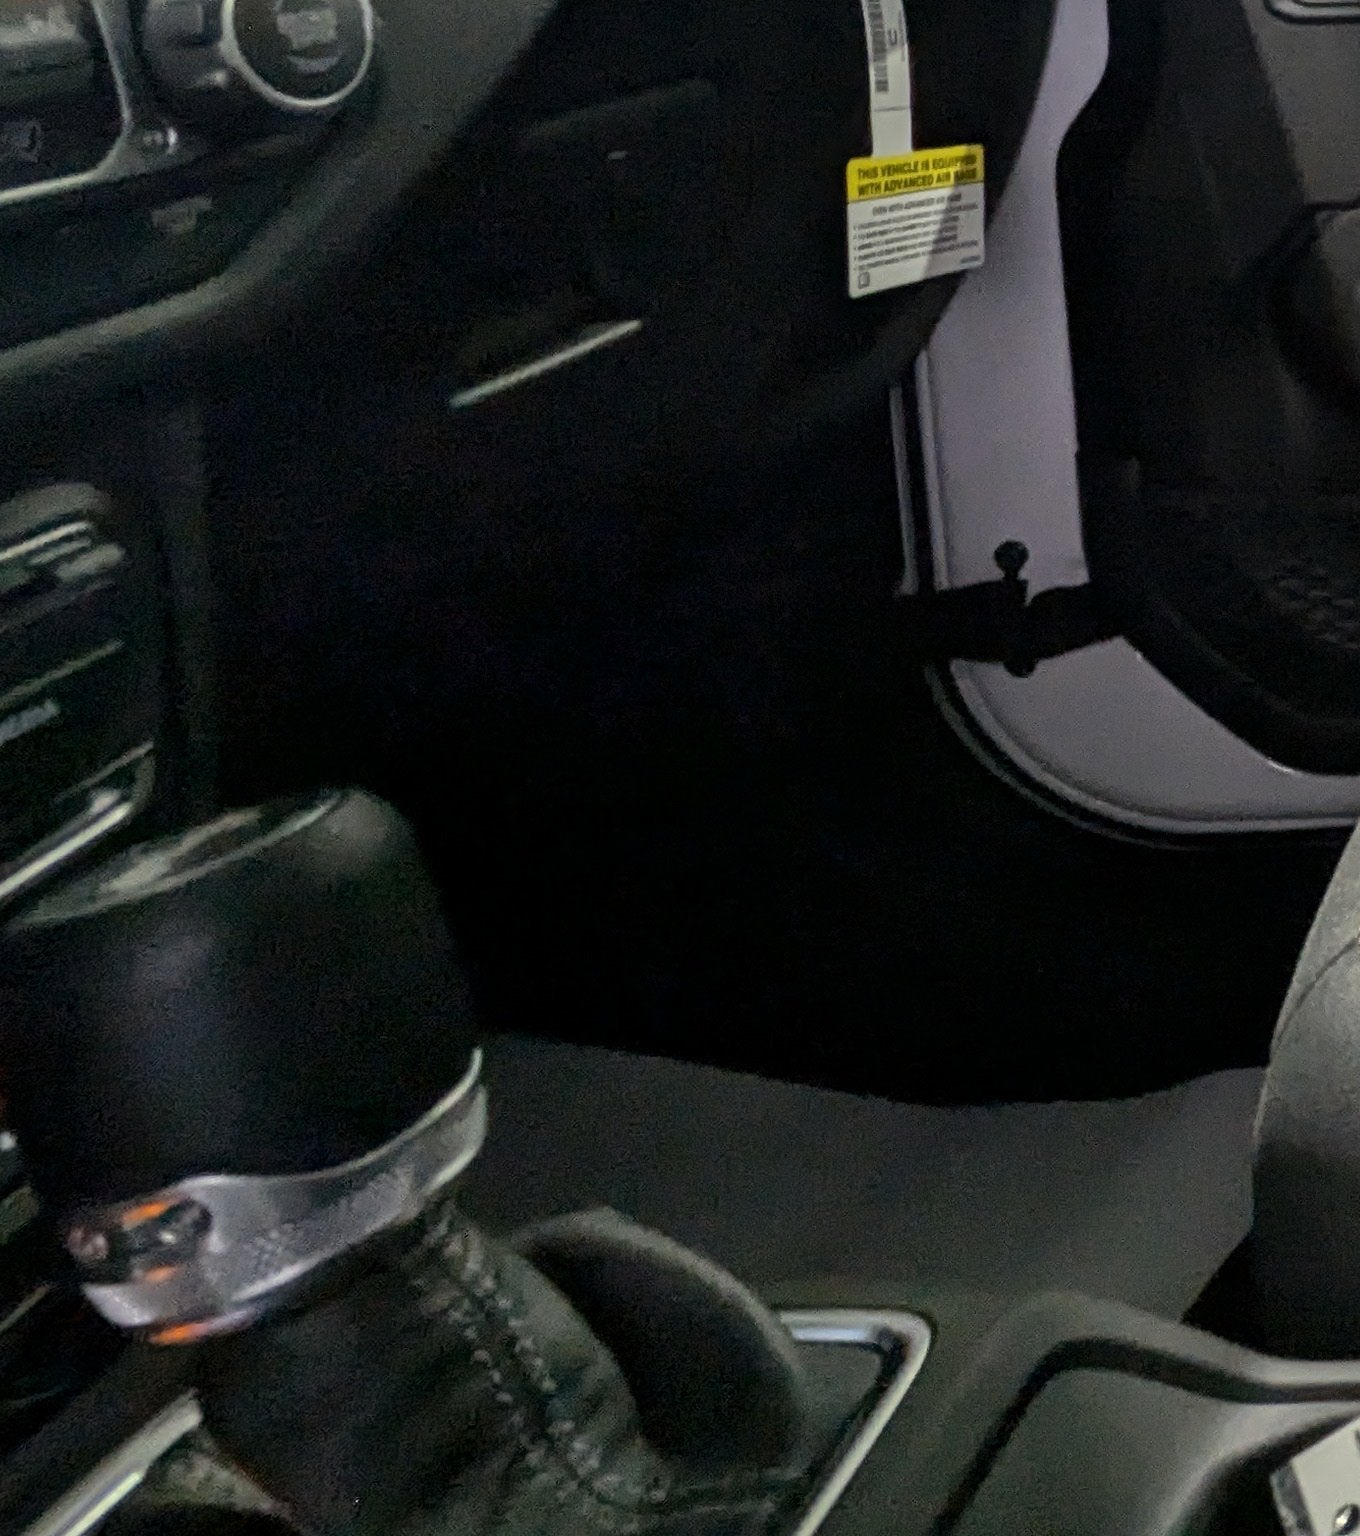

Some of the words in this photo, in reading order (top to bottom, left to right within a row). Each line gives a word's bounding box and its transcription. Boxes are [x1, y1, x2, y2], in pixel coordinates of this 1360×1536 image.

[881, 161, 919, 178] VEHICLE
[857, 181, 881, 197] WITH
[883, 173, 934, 194] ADVANCED
[936, 170, 951, 184] AIR
